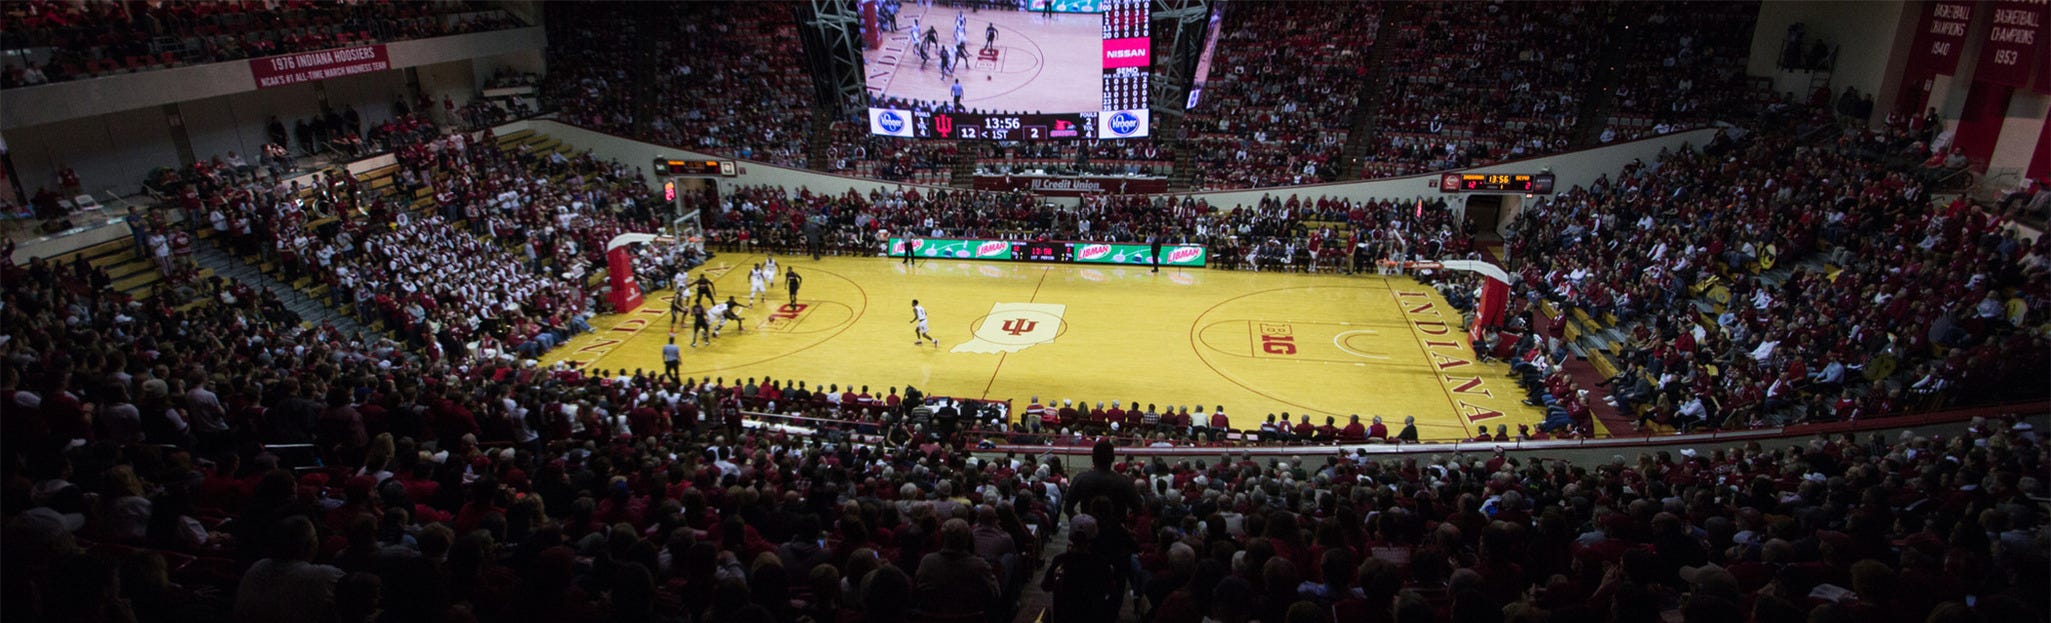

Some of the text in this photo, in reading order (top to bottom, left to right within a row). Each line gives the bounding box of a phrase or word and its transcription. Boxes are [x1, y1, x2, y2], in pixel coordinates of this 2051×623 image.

[1934, 3, 1971, 20] BASKETBALL
[1993, 9, 2040, 27] BASKETBALL
[1930, 20, 1966, 36] CHAMPIONS
[1990, 27, 2035, 45] CHAMPIONS
[271, 47, 375, 71] 1976 INDIANA HOOSIERS
[1107, 49, 1146, 58] NISSAN
[1994, 49, 2018, 65] 1953
[261, 76, 285, 87] NCAA'S
[296, 70, 323, 82] ALL-TIME
[324, 68, 345, 76] MARCH
[346, 64, 372, 74] MADNESS
[373, 61, 386, 70] TEAM
[880, 114, 902, 131] Kroger
[985, 118, 1020, 129] 13:56
[1112, 115, 1137, 132] Kroger
[961, 128, 976, 138] 12
[992, 131, 1008, 139] 1ST
[1031, 128, 1039, 138] 2
[1043, 179, 1071, 189] Credit
[1073, 180, 1100, 189] Union
[1489, 175, 1509, 183] 13:56
[1525, 181, 1531, 190] 2
[975, 240, 1006, 257] LIBMAN
[1077, 245, 1108, 261] LIBMAN
[1167, 248, 1198, 264] LIBMAN
[1397, 290, 1504, 425] INDIANA
